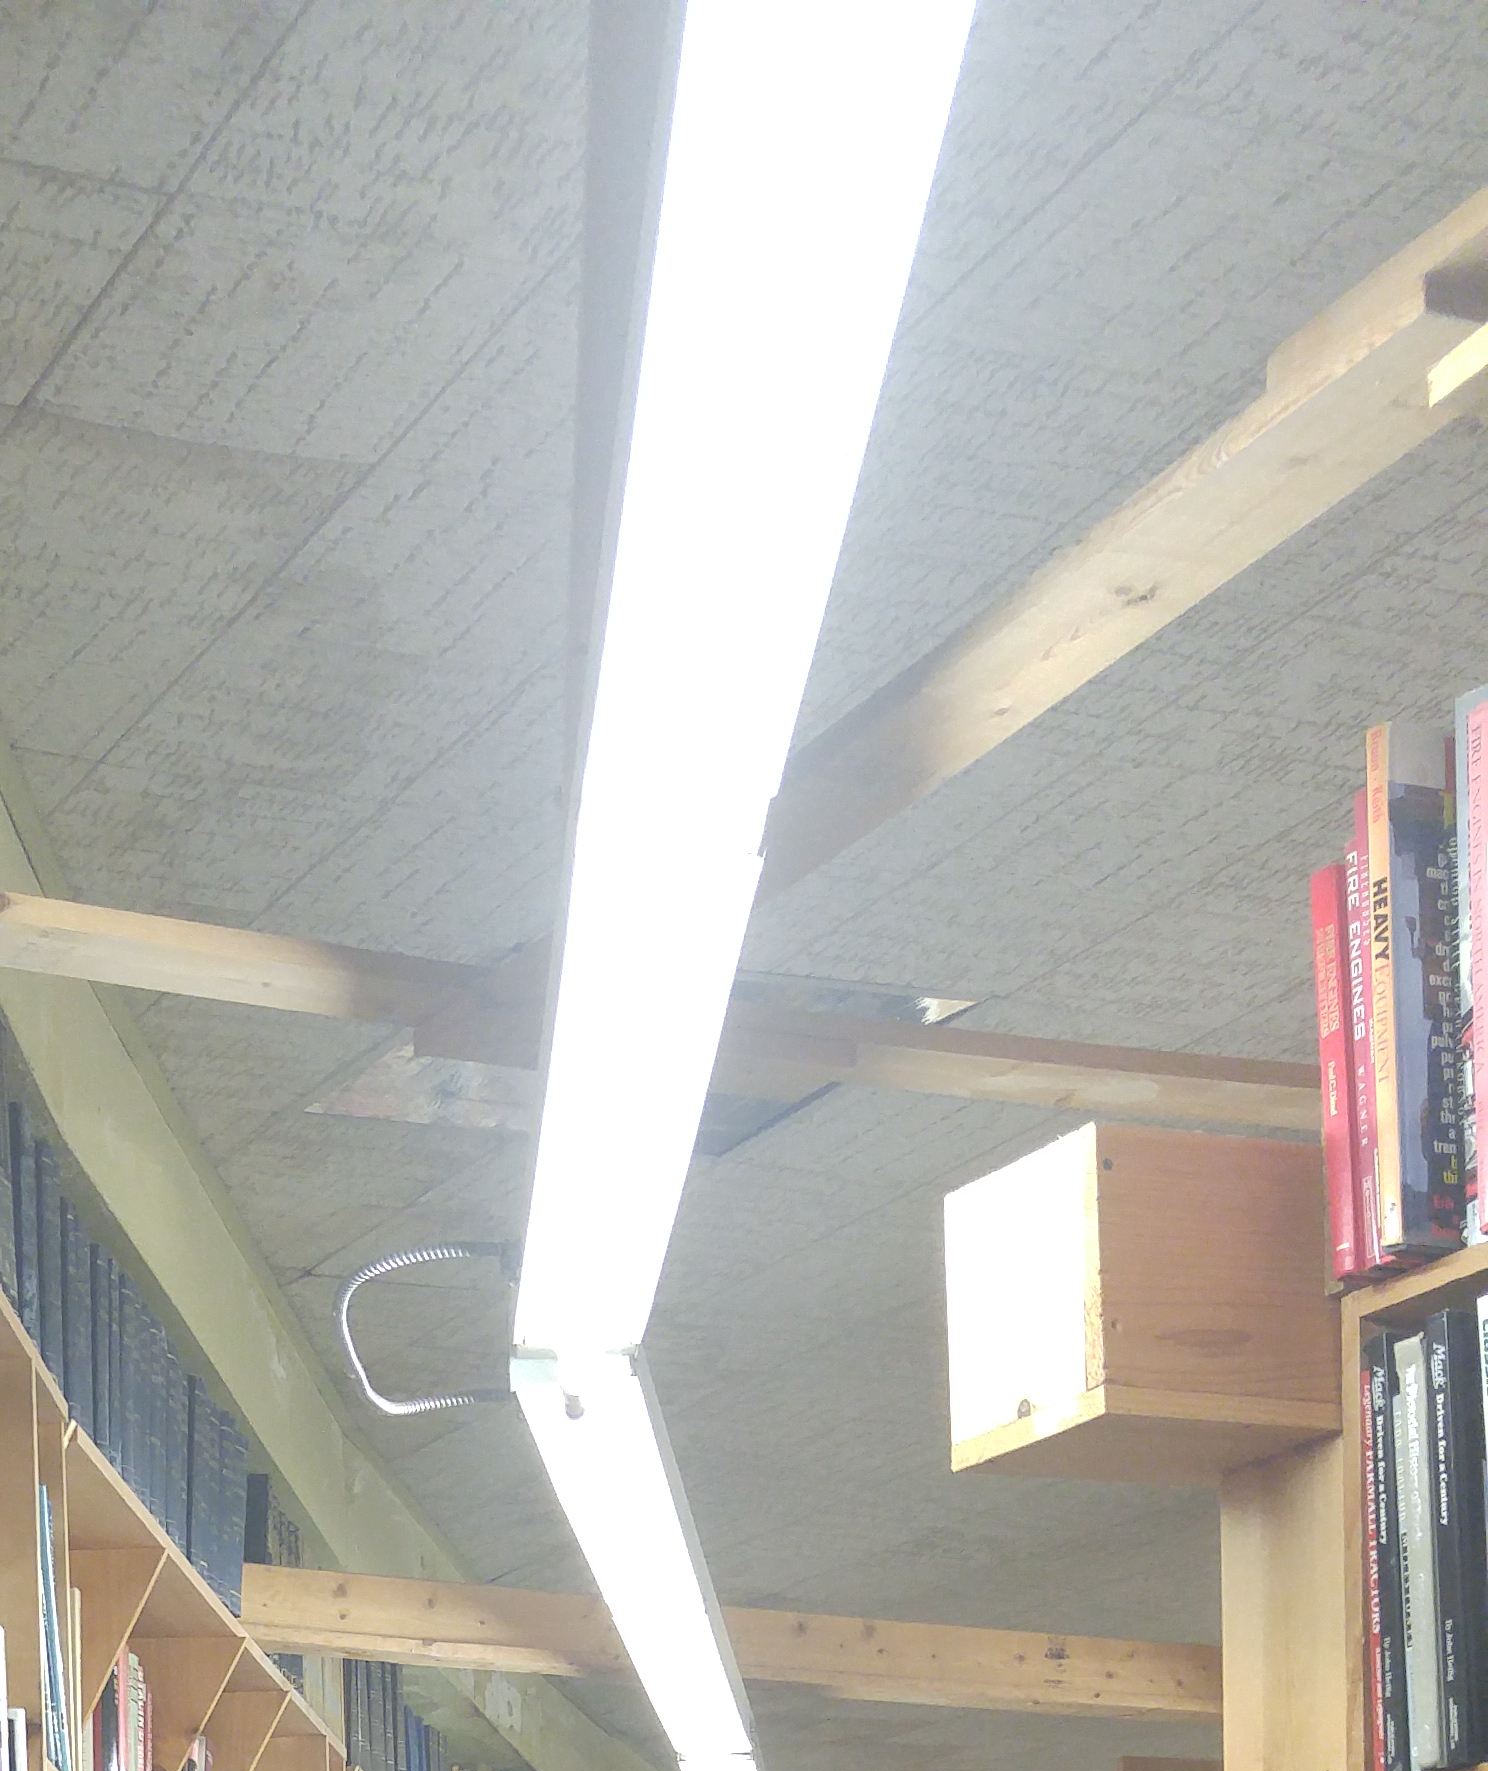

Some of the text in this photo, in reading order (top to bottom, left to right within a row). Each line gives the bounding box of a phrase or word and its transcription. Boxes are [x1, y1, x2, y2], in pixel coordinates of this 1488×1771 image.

[1345, 850, 1366, 1042] FIRE ENGINES
[1372, 876, 1390, 961] HEAVY
[1436, 1394, 1446, 1434] Driven
[1438, 1471, 1448, 1527] Century
